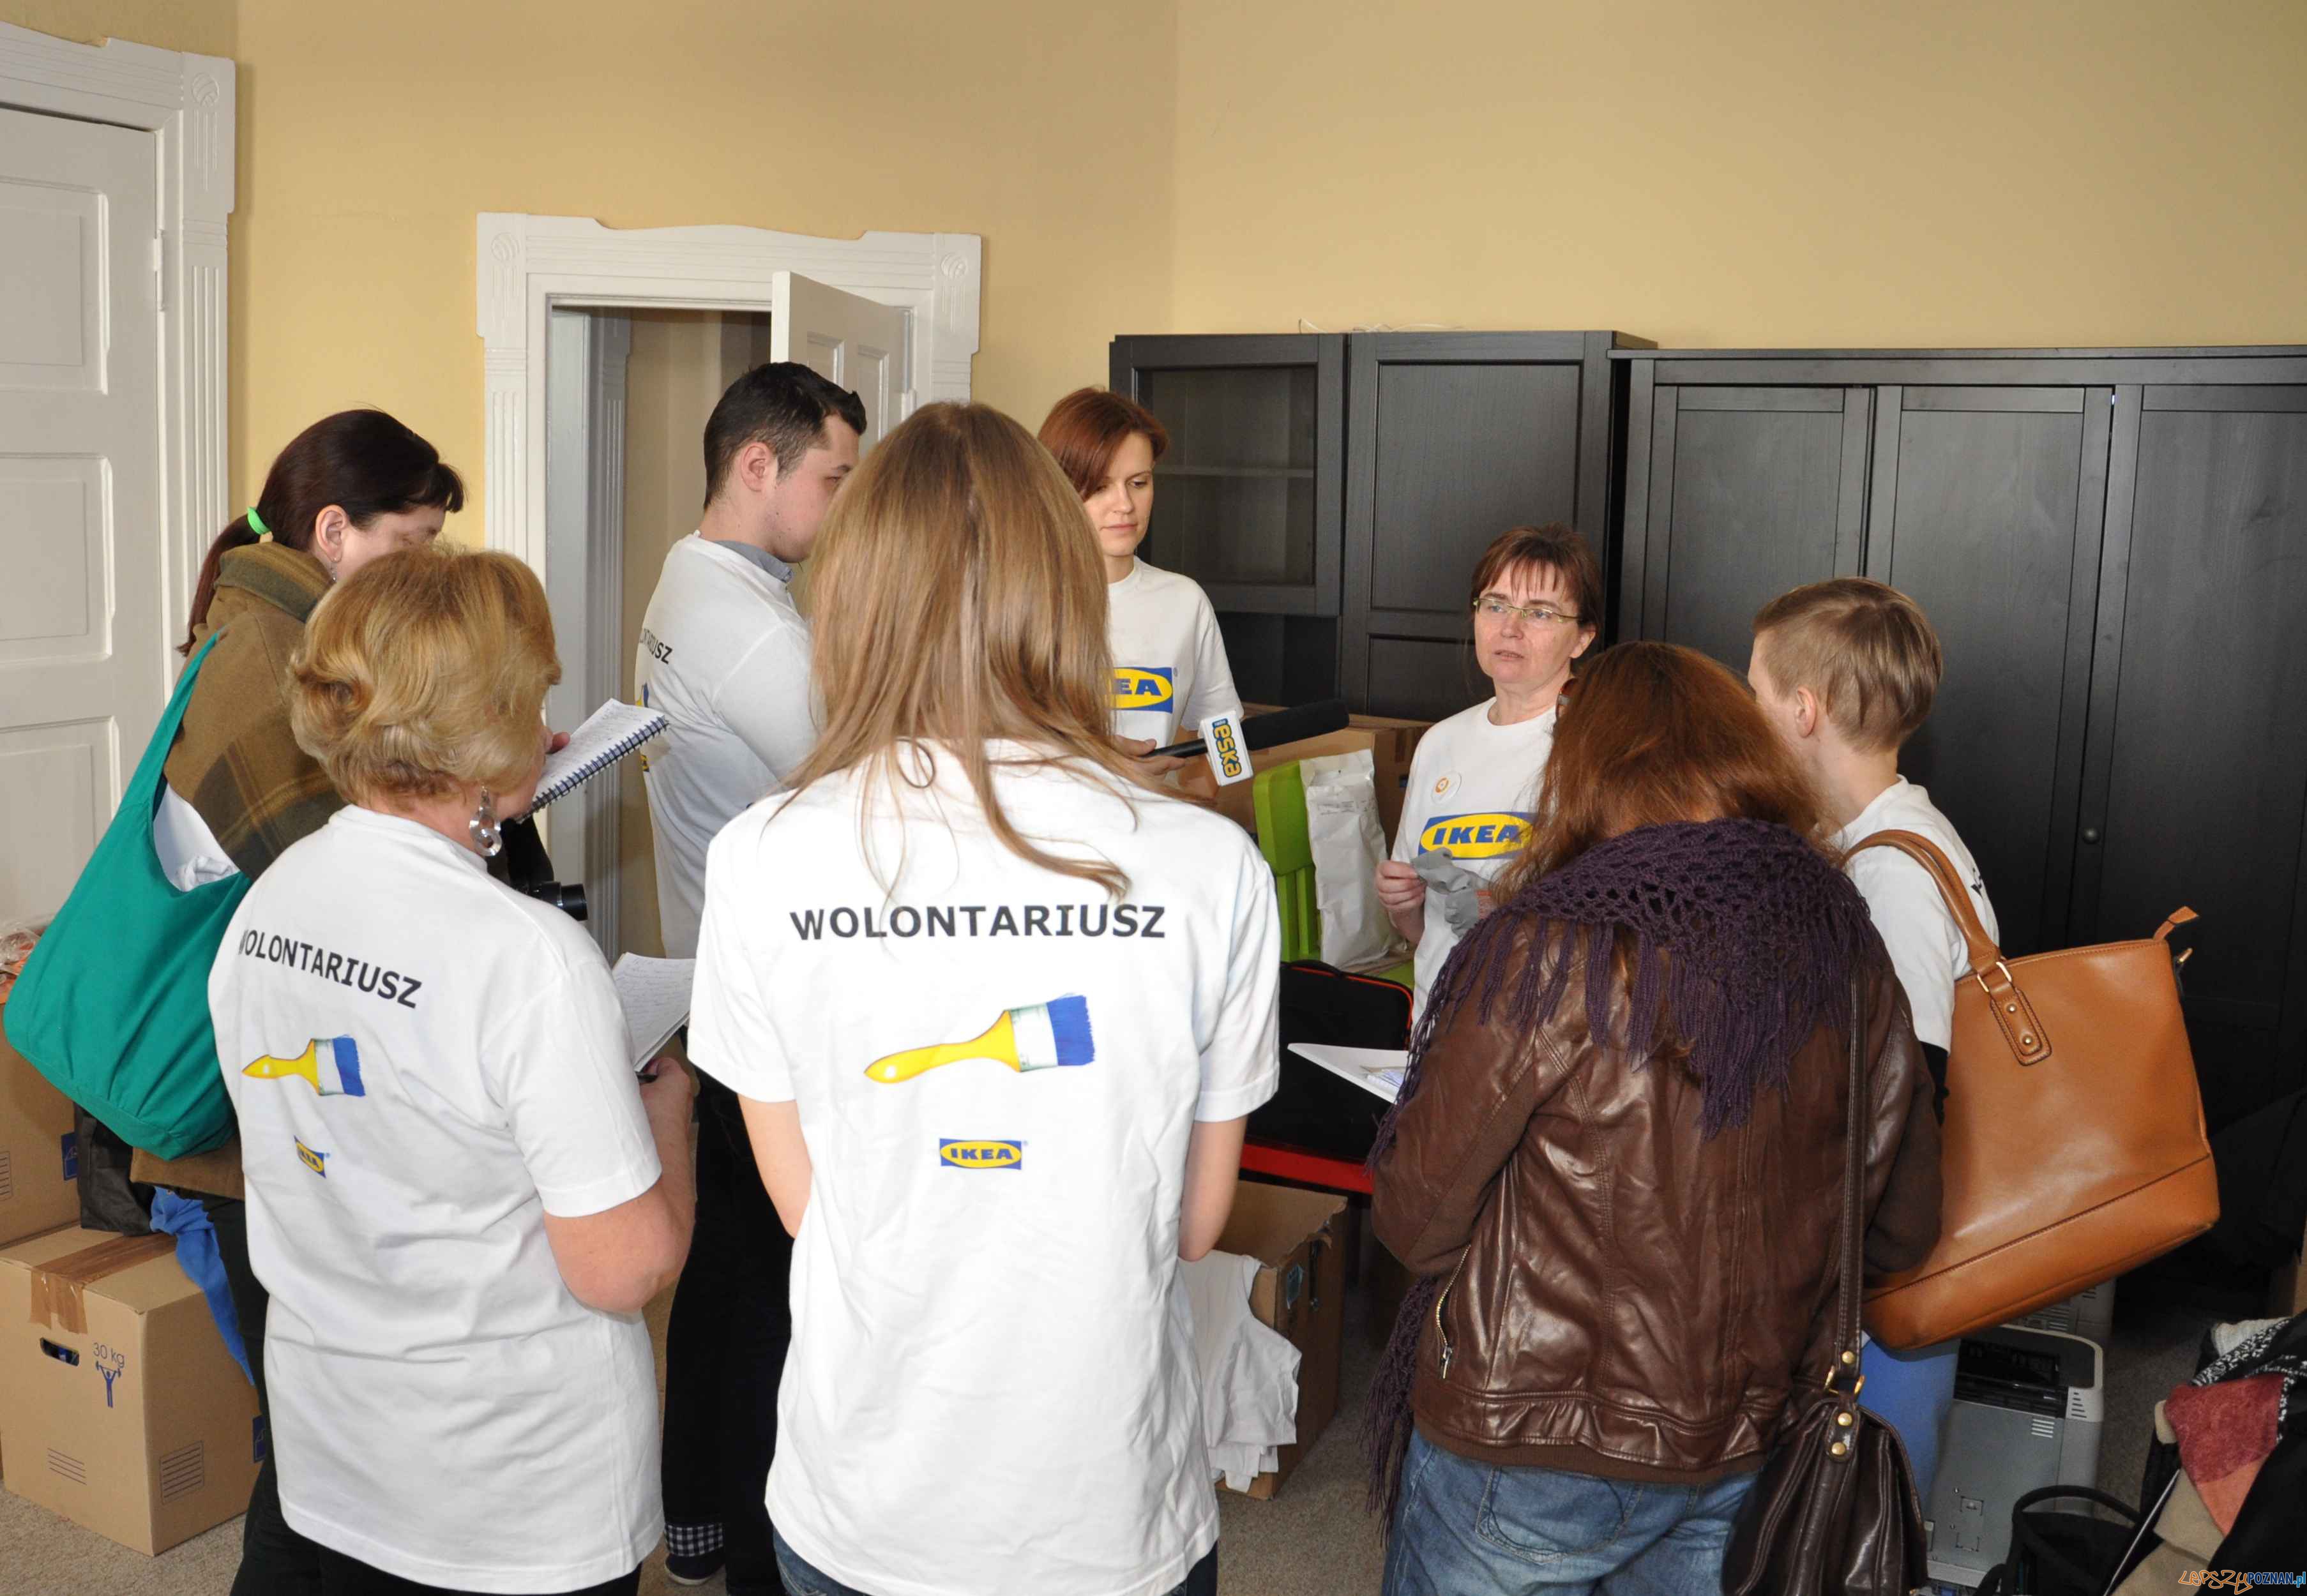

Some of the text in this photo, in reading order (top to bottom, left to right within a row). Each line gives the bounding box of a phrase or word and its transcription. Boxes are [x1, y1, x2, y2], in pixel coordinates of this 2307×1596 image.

[1114, 679, 1161, 695] EA
[1213, 724, 1242, 778] eska
[1433, 824, 1522, 845] IKEA
[790, 904, 1165, 940] WOLONTARIUSZ
[950, 1148, 1013, 1160] IKEA
[93, 1342, 125, 1369] 30 kg
